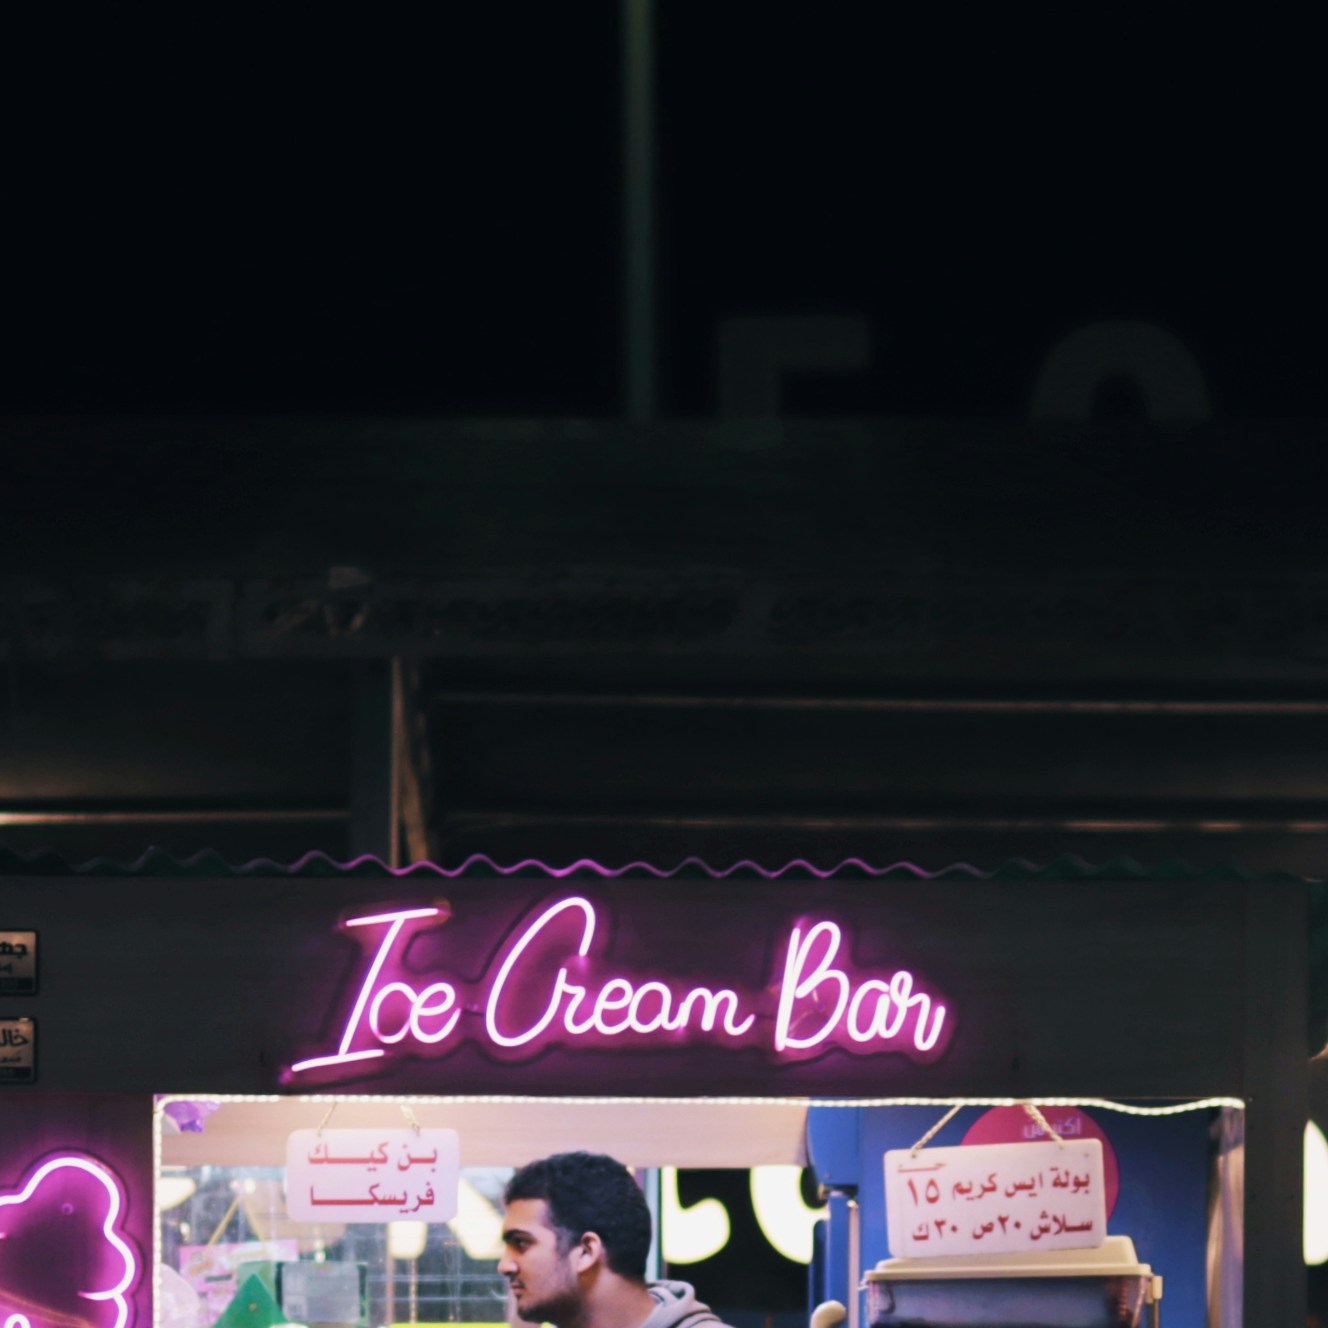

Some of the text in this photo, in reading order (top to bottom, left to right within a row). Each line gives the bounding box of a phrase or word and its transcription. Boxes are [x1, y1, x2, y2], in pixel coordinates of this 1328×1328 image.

[291, 895, 946, 1073] Ice Cream Bar
[307, 1142, 437, 1172] بن كيك
[952, 1173, 997, 1200] كريم
[1050, 1166, 1090, 1194] بولة
[310, 1181, 435, 1213] فريسكا
[1029, 1209, 1093, 1240] سلاش
